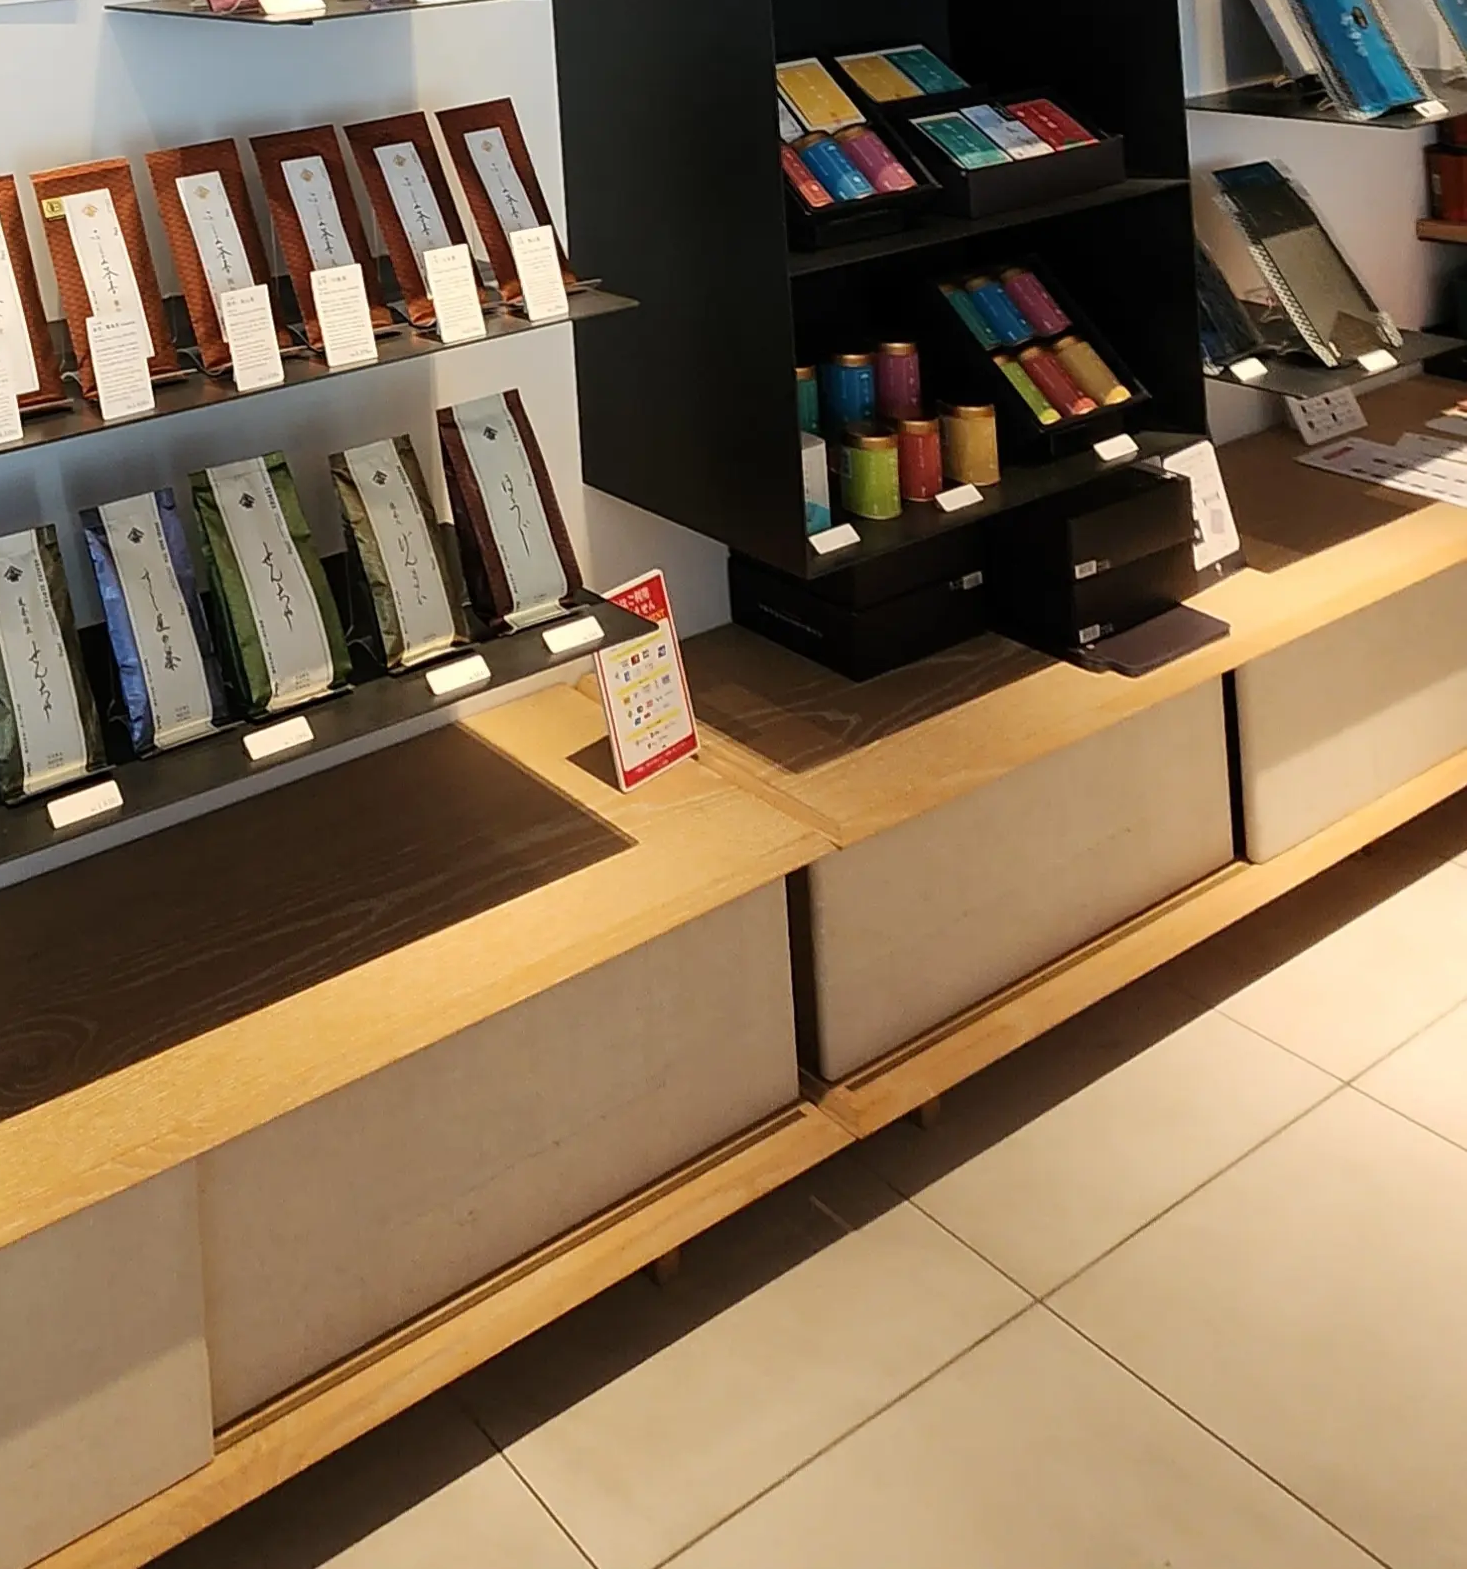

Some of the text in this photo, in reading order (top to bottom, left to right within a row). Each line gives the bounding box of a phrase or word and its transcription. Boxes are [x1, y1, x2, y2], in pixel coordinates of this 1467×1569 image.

[261, 540, 294, 633] せんちゃ
[28, 639, 53, 725] せんちゃ
